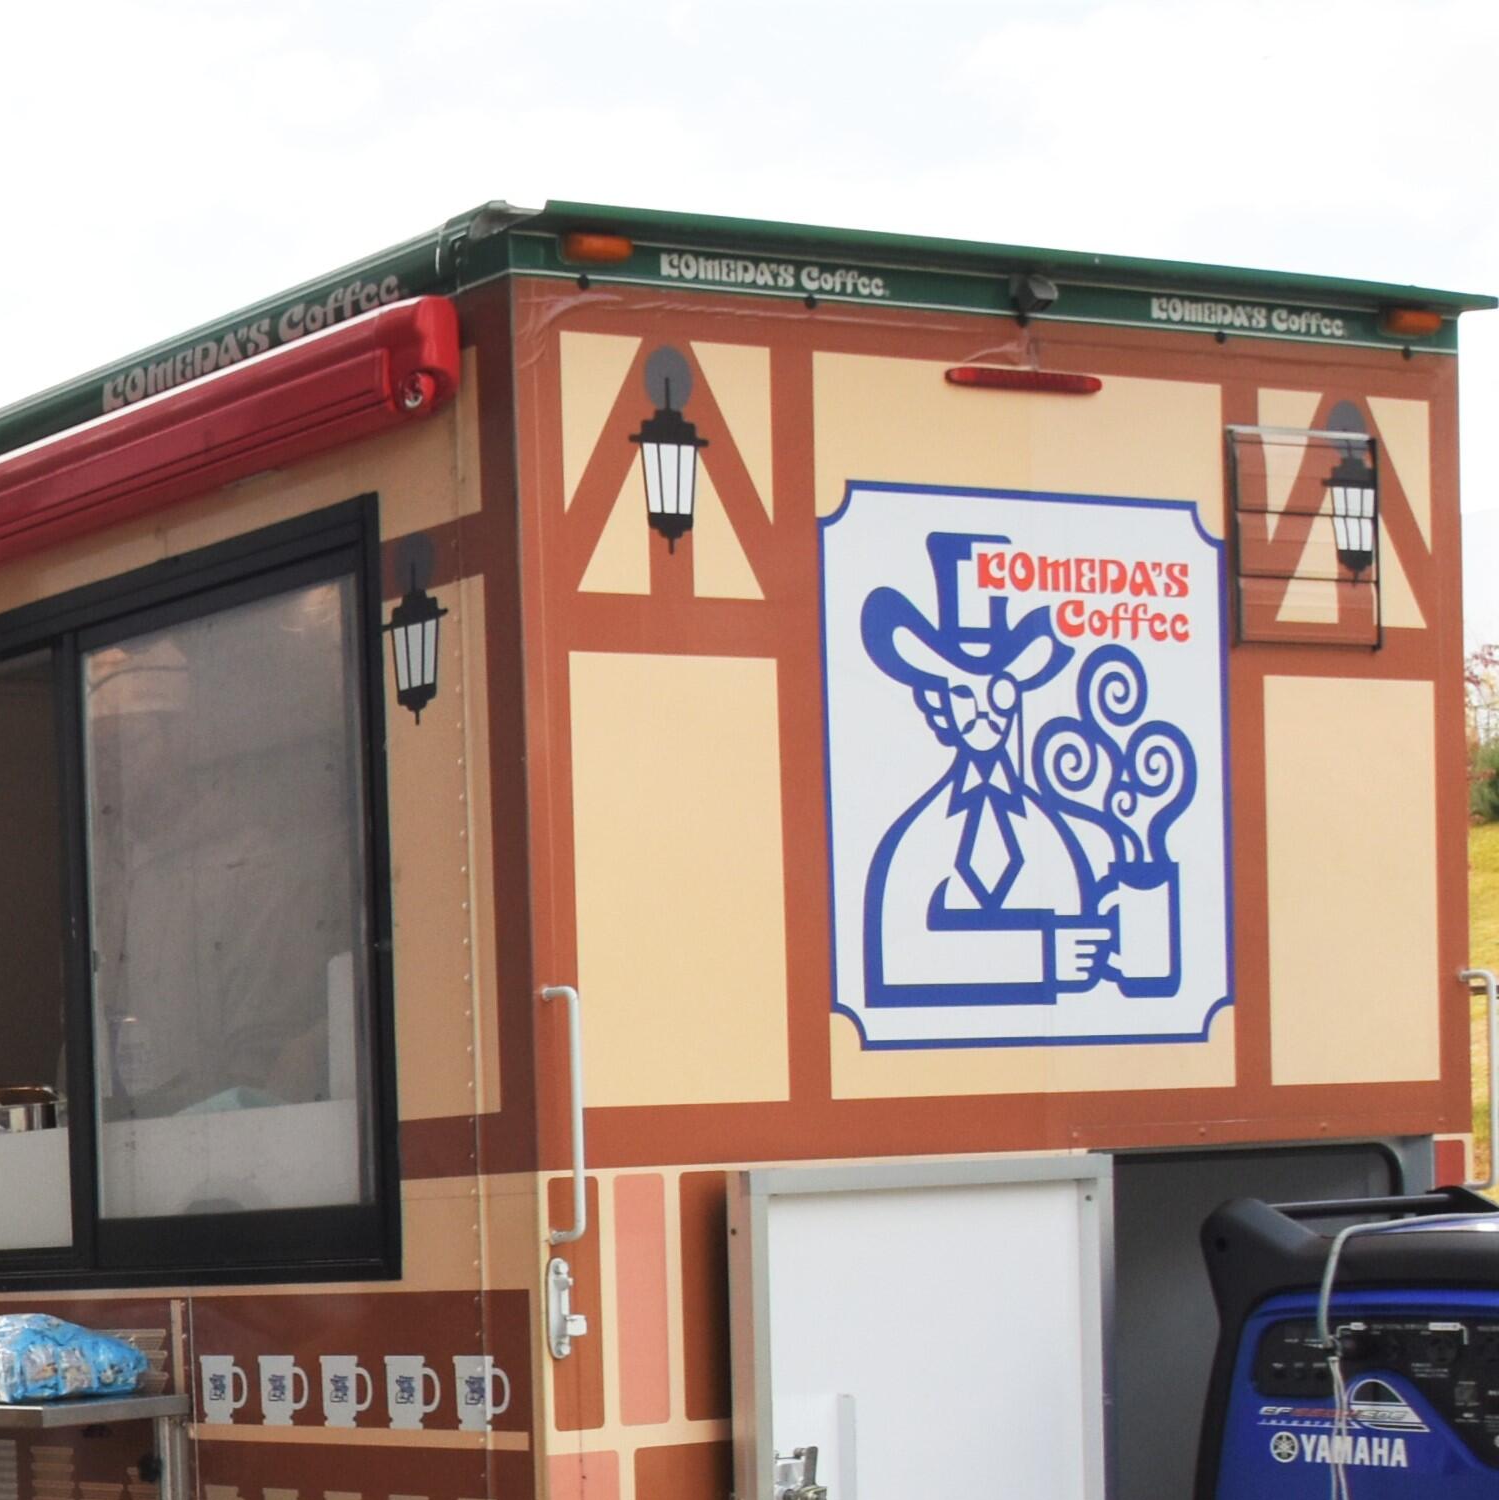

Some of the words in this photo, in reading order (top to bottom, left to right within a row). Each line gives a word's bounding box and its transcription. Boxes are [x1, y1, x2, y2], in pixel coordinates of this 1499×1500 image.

[660, 253, 796, 288] KOMEDA'S
[801, 266, 885, 297] Coffee
[1150, 297, 1268, 329] KOMEDA'S
[1271, 308, 1345, 337] Coffee
[102, 318, 273, 413] KOMEDA'S
[278, 274, 401, 342] Coffee
[977, 551, 1190, 598] KOMEDA'S
[1056, 600, 1191, 642] Coffee
[1300, 1433, 1408, 1468] YAMAHA
